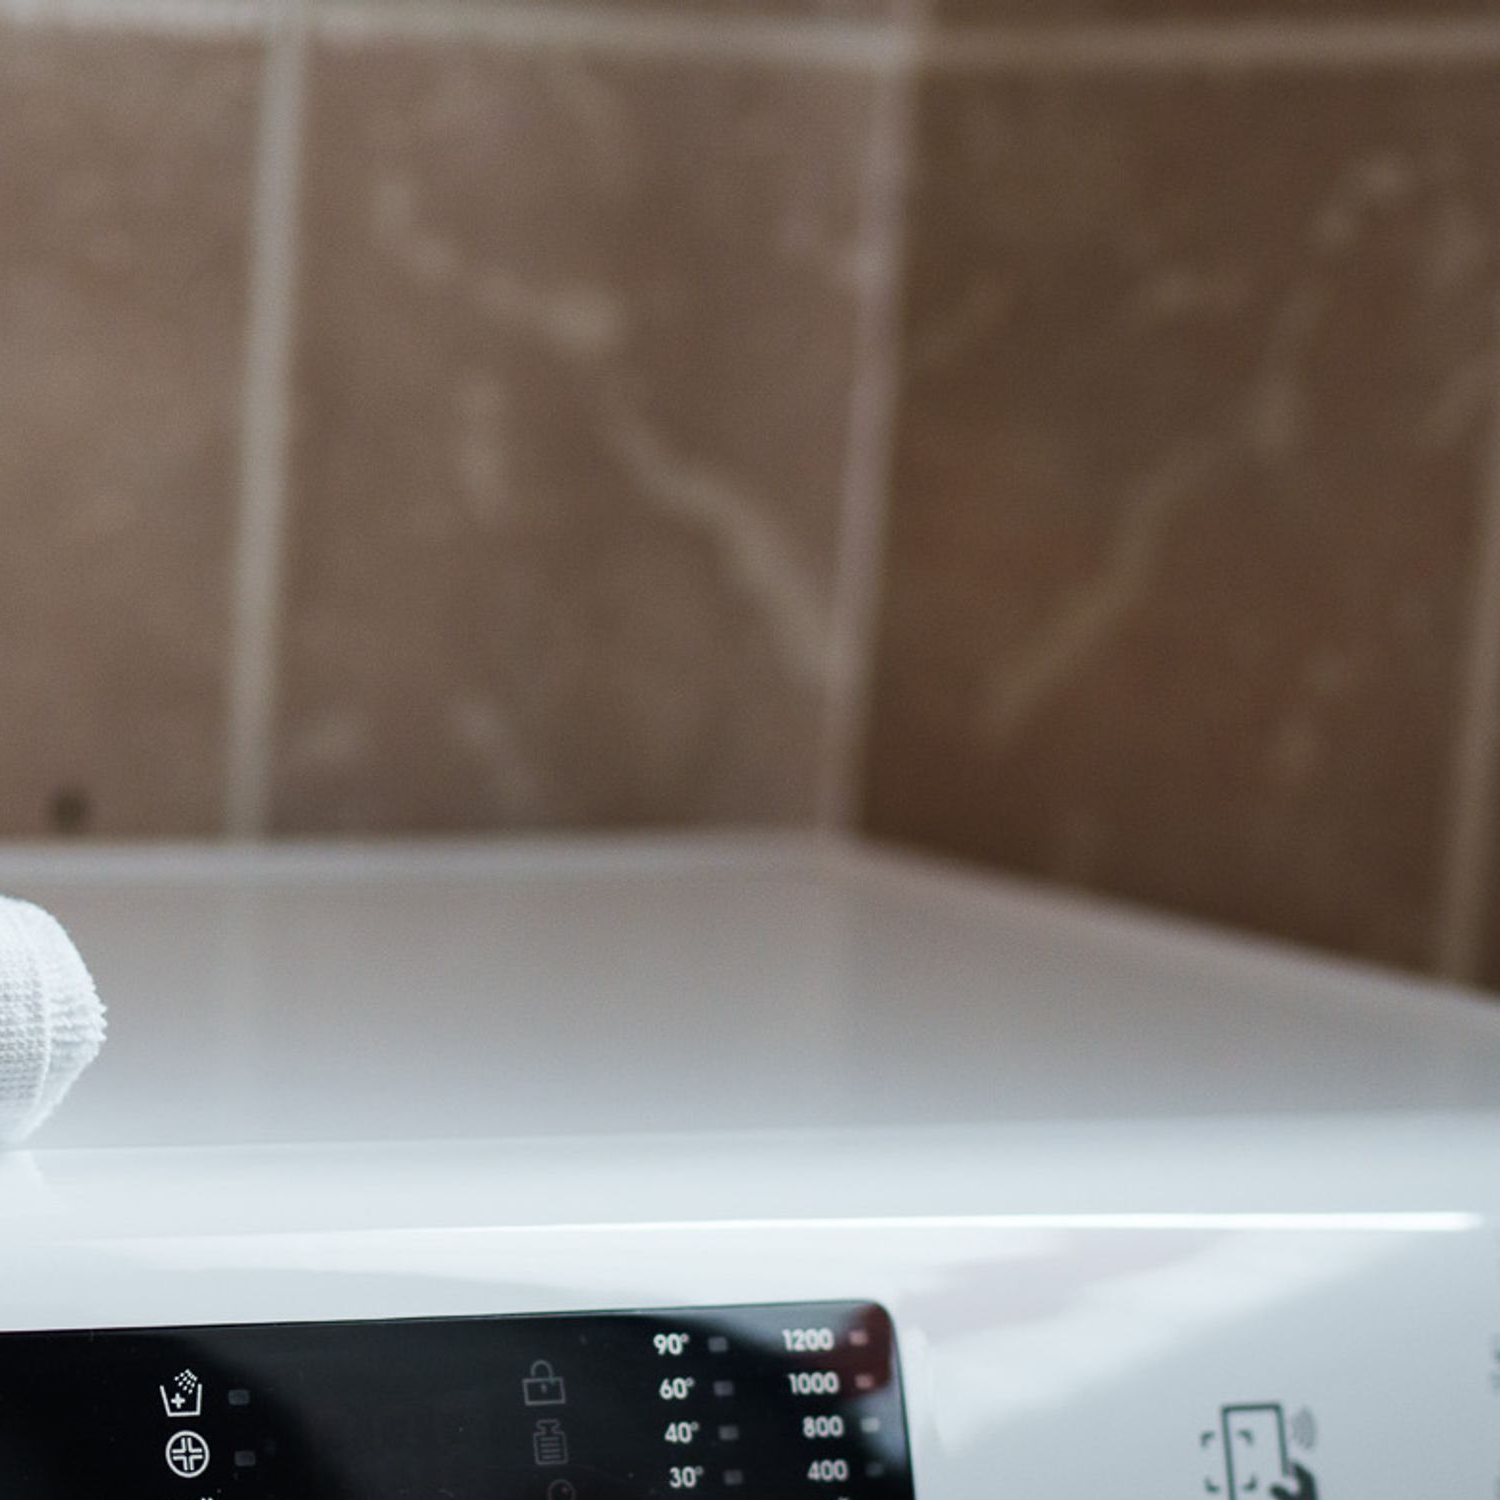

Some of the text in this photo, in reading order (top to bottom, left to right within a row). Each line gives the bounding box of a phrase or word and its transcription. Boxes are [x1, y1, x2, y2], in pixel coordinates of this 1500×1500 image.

[782, 1328, 834, 1351] 1200
[787, 1372, 840, 1395] 1000
[803, 1415, 844, 1438] 800
[807, 1459, 849, 1481] 400
